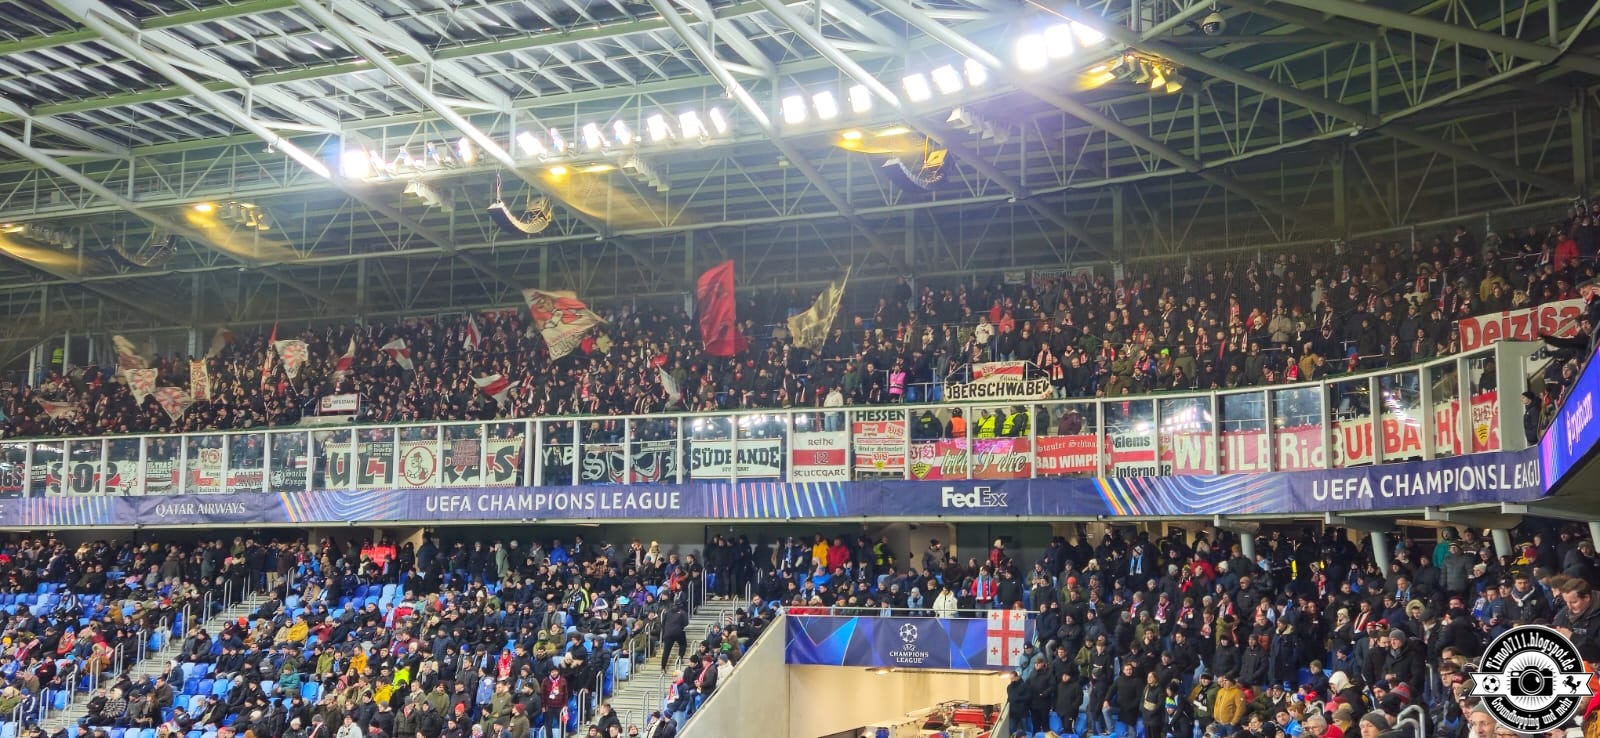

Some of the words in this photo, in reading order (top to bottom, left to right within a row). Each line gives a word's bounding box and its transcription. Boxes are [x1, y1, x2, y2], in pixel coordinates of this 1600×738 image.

[856, 410, 905, 421] HESSEN
[1345, 409, 1450, 460] URBAH
[813, 451, 829, 465] 12
[1312, 478, 1374, 501] UEFA
[1380, 464, 1498, 498] CHAMPIONS
[425, 496, 472, 512] UEFA
[478, 493, 595, 511] CHAMPIONS
[601, 492, 681, 510] LEAGUE
[941, 486, 1008, 508] FedEx
[155, 503, 194, 517] QATAR
[197, 502, 246, 515] AIRWAYS
[889, 650, 929, 658] CHAMPIONS
